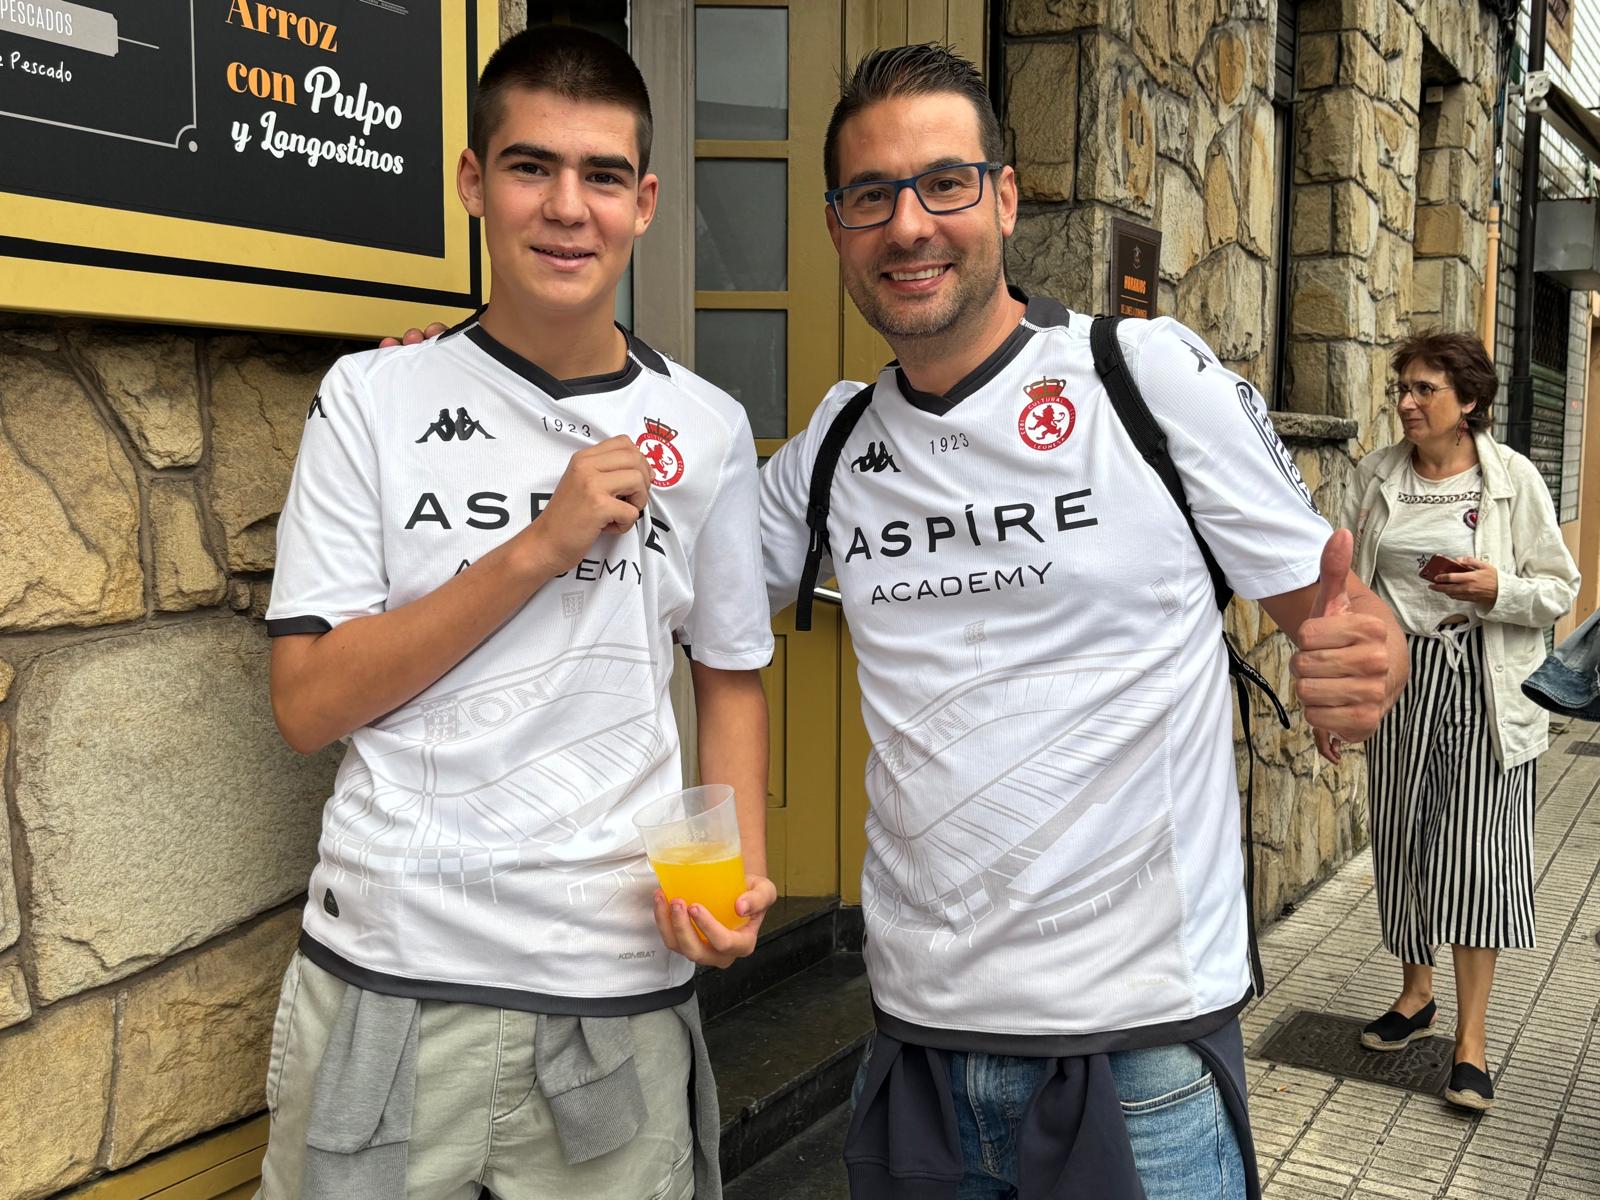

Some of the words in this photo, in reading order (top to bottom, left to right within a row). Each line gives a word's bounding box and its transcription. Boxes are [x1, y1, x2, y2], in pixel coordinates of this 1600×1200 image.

[0, 0, 73, 36] PESCADOS
[225, 0, 338, 53] Arroz
[10, 51, 73, 83] Pescado
[226, 61, 298, 106] con
[303, 65, 403, 136] Pulpo
[230, 120, 252, 153] y
[259, 110, 404, 175] Langostinos
[1027, 396, 1064, 410] CULTURAL
[541, 415, 592, 438] 1923
[929, 432, 970, 456] 1923
[870, 561, 1053, 605] ACADEMY
[617, 950, 657, 960] KOMBAT
